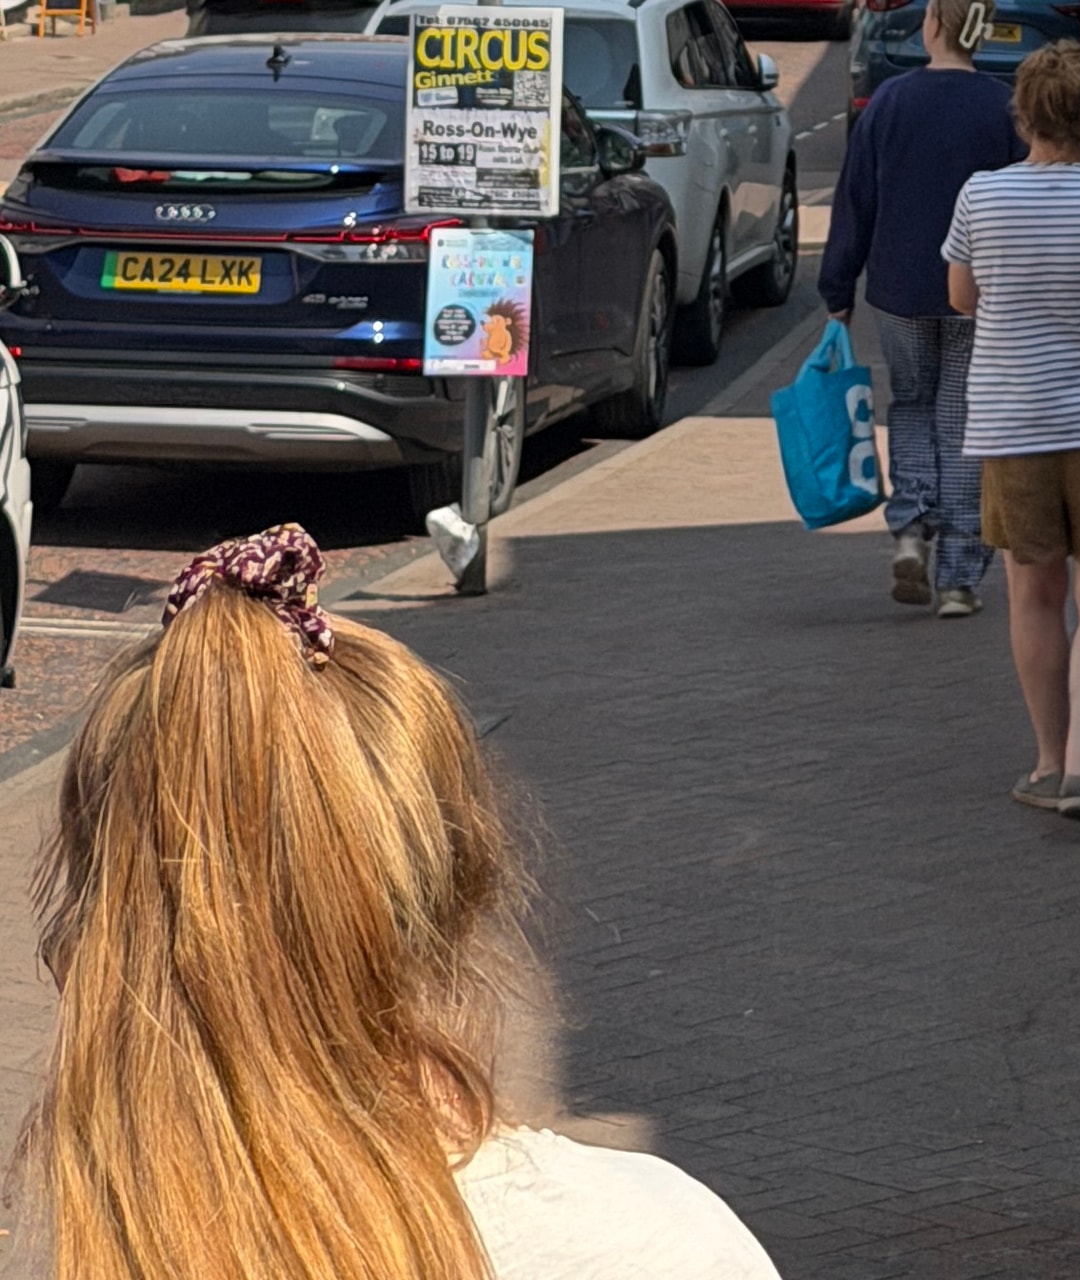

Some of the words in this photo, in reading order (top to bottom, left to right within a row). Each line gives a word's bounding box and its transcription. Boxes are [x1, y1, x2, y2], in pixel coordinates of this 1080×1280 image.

[417, 28, 550, 71] CIRCUS
[415, 70, 493, 89] Ginnett
[423, 120, 538, 142] Ross-On-Wye
[421, 145, 437, 160] 15
[440, 145, 455, 160] to
[457, 145, 475, 161] 19
[121, 257, 192, 283] CA24
[201, 259, 254, 286] LXK
